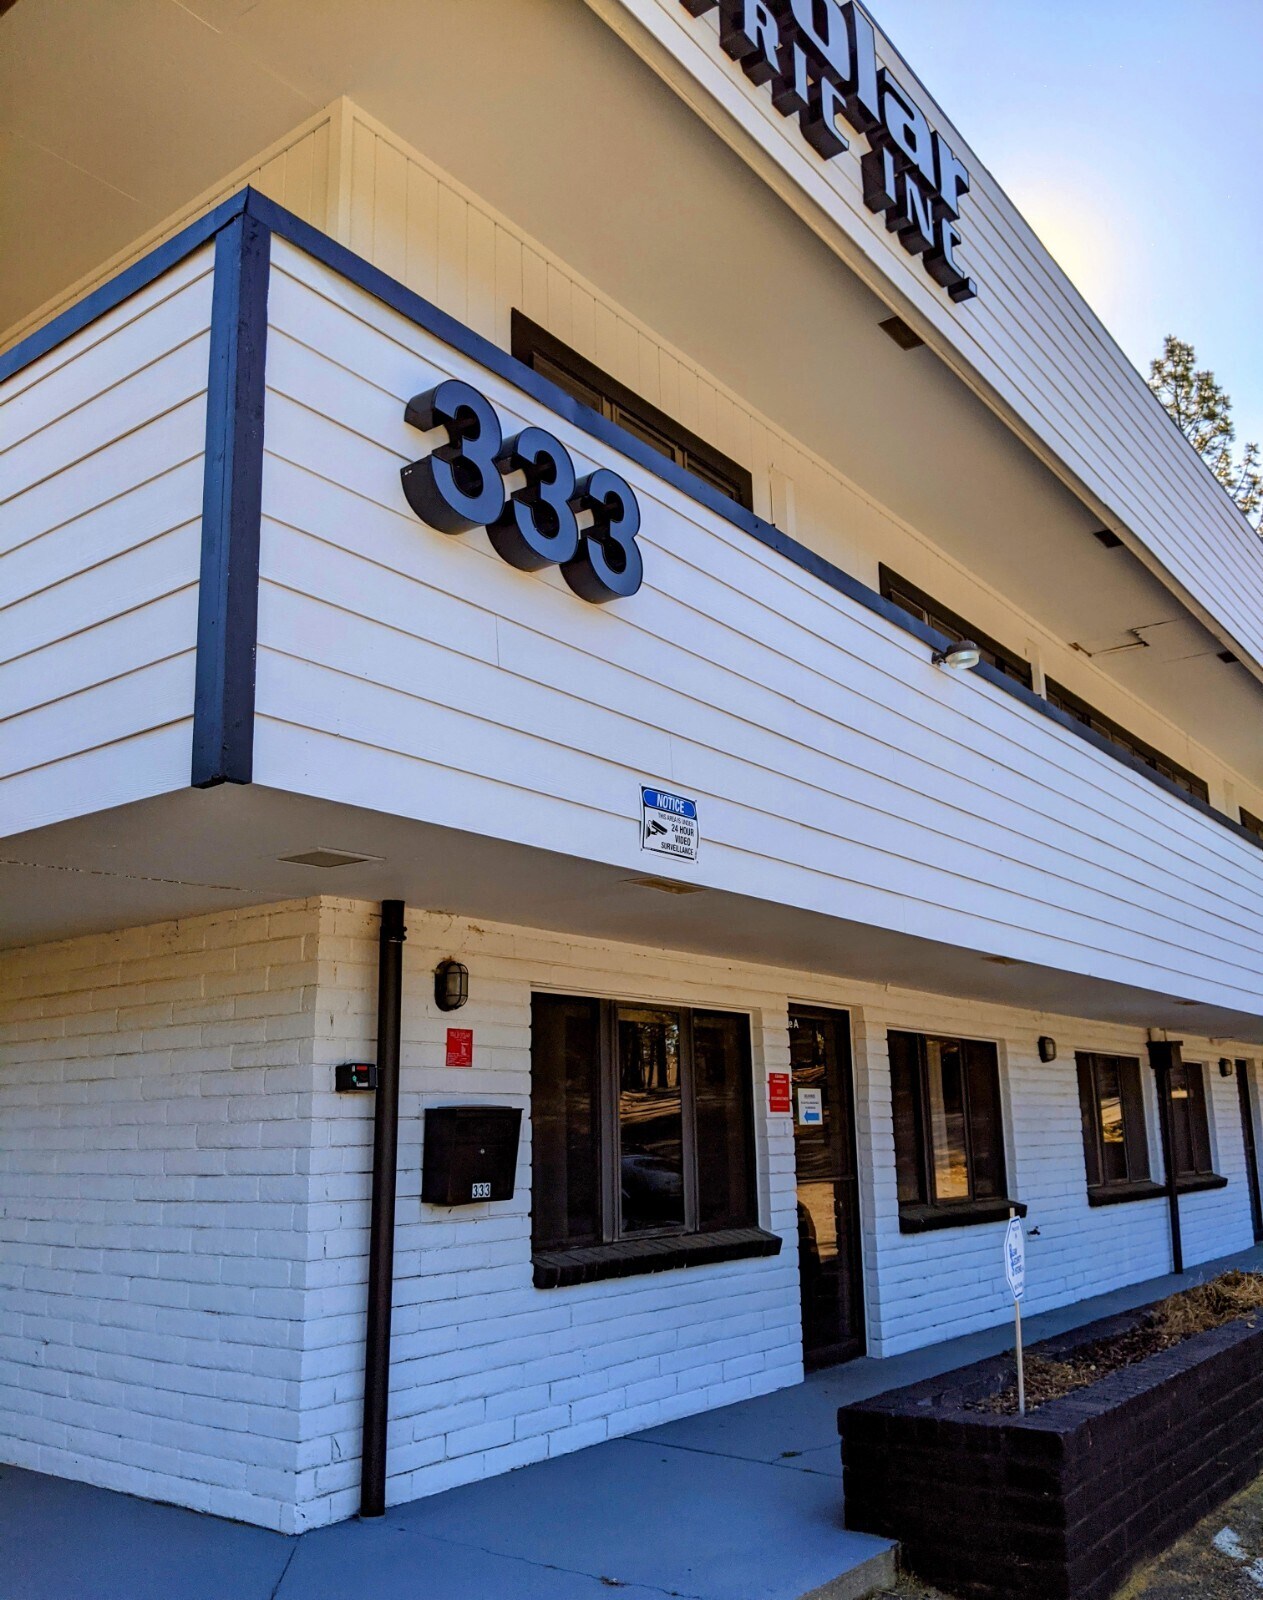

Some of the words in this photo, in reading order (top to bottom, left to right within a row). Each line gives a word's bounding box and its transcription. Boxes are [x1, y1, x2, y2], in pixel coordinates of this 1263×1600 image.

[402, 379, 643, 603] 333
[656, 793, 685, 813] NOTICE
[671, 823, 679, 833] 24
[679, 825, 694, 837] HOUR
[675, 834, 691, 846] VIDEO
[660, 841, 694, 856] SURVEILLANCE
[472, 1183, 491, 1197] 333
